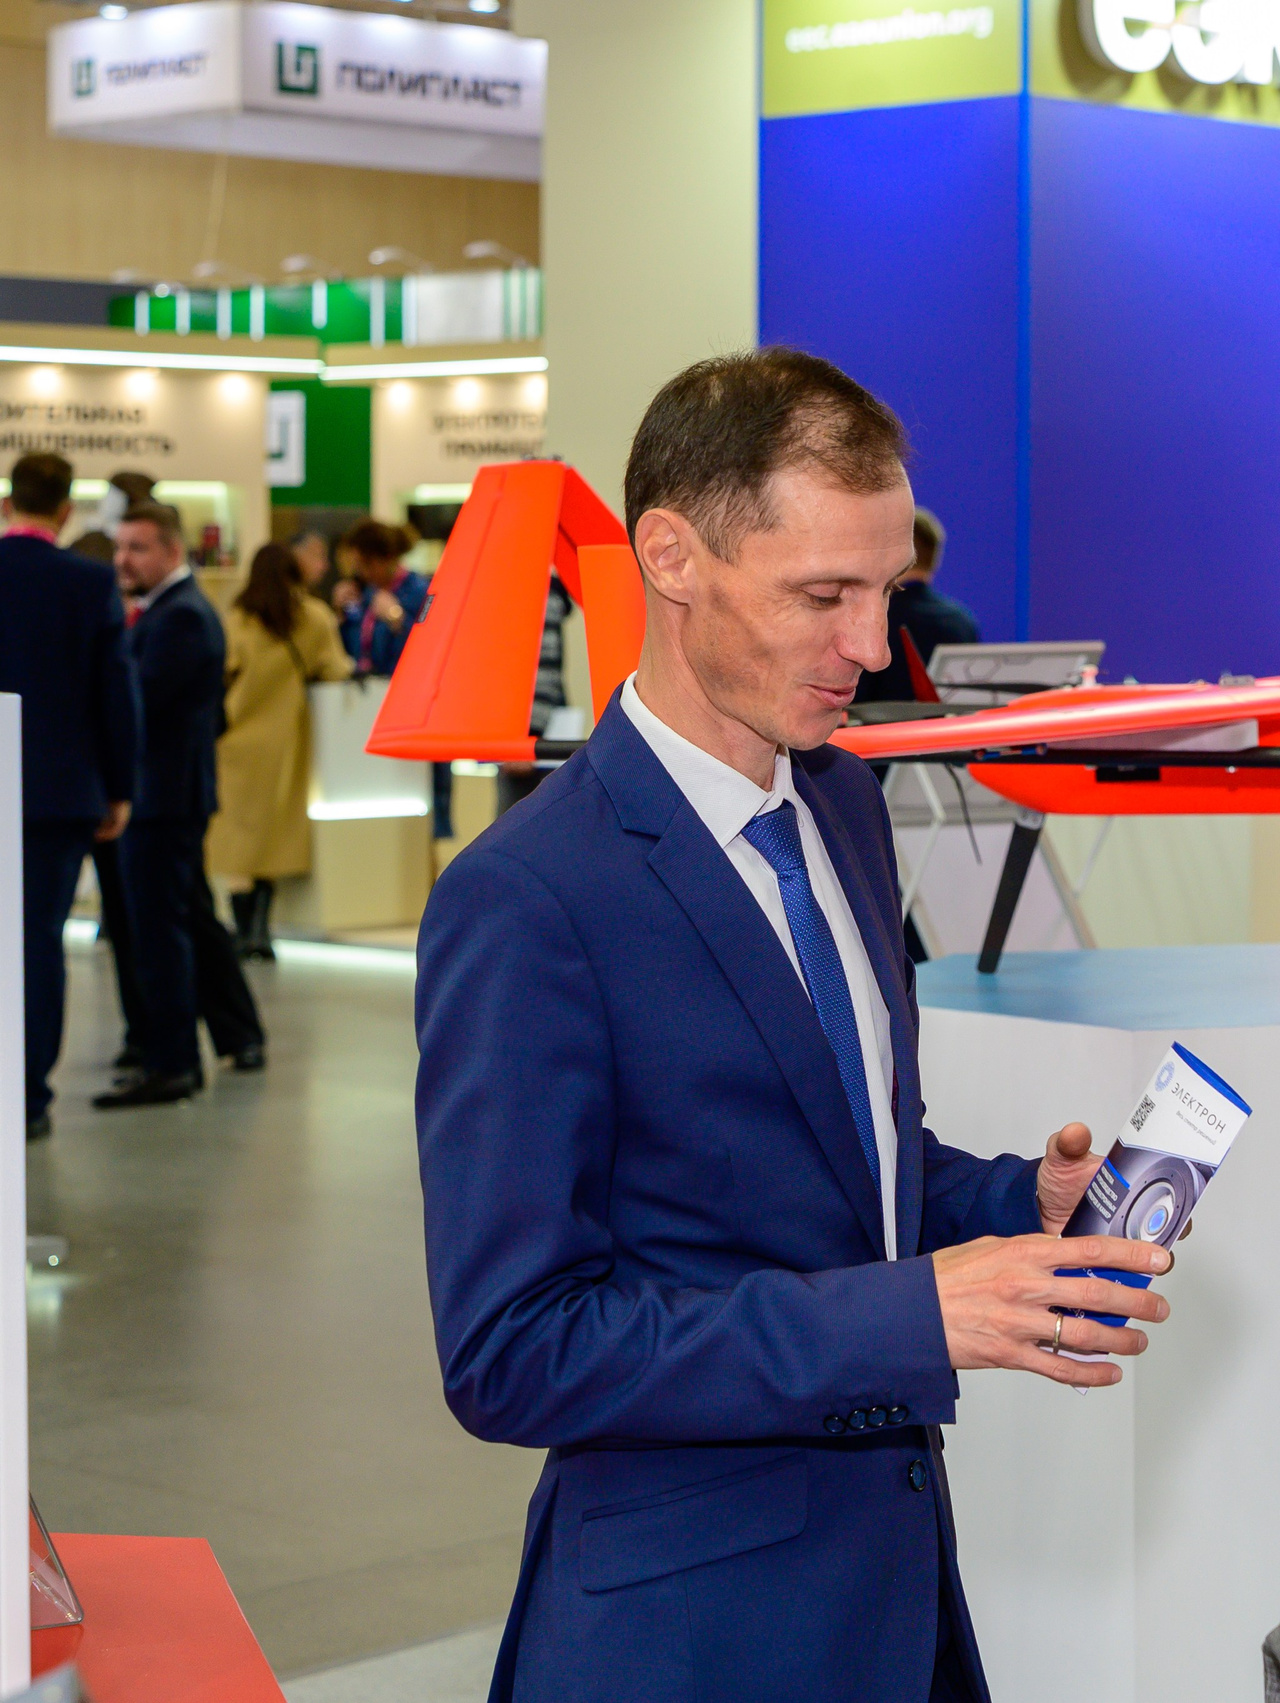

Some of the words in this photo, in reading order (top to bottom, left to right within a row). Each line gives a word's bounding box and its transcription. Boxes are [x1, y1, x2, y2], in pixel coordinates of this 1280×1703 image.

[105, 52, 207, 85] ПОЛИПЛАСТ
[336, 60, 524, 108] ПОЛИПЛАСТ
[1171, 1082, 1227, 1134] ЭЛЕКТРОН
